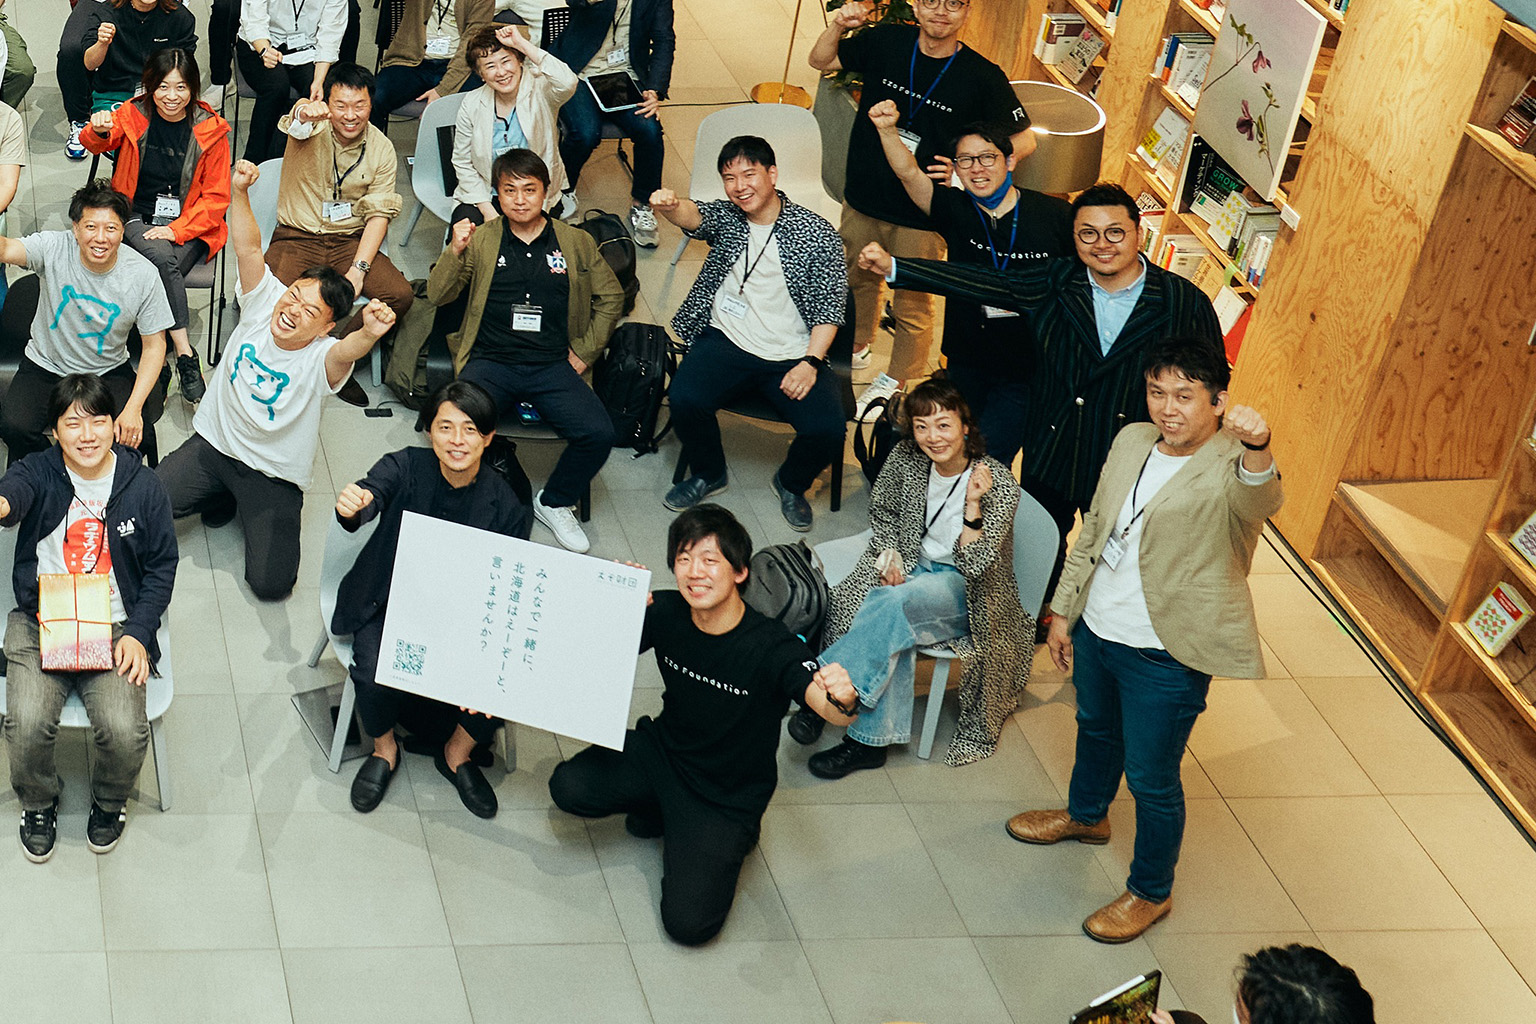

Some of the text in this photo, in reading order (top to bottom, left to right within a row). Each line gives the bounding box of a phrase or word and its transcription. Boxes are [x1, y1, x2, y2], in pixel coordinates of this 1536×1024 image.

[1212, 169, 1239, 190] GROW
[522, 567, 549, 672] みんなで一緒に、
[682, 666, 749, 696] Foundation
